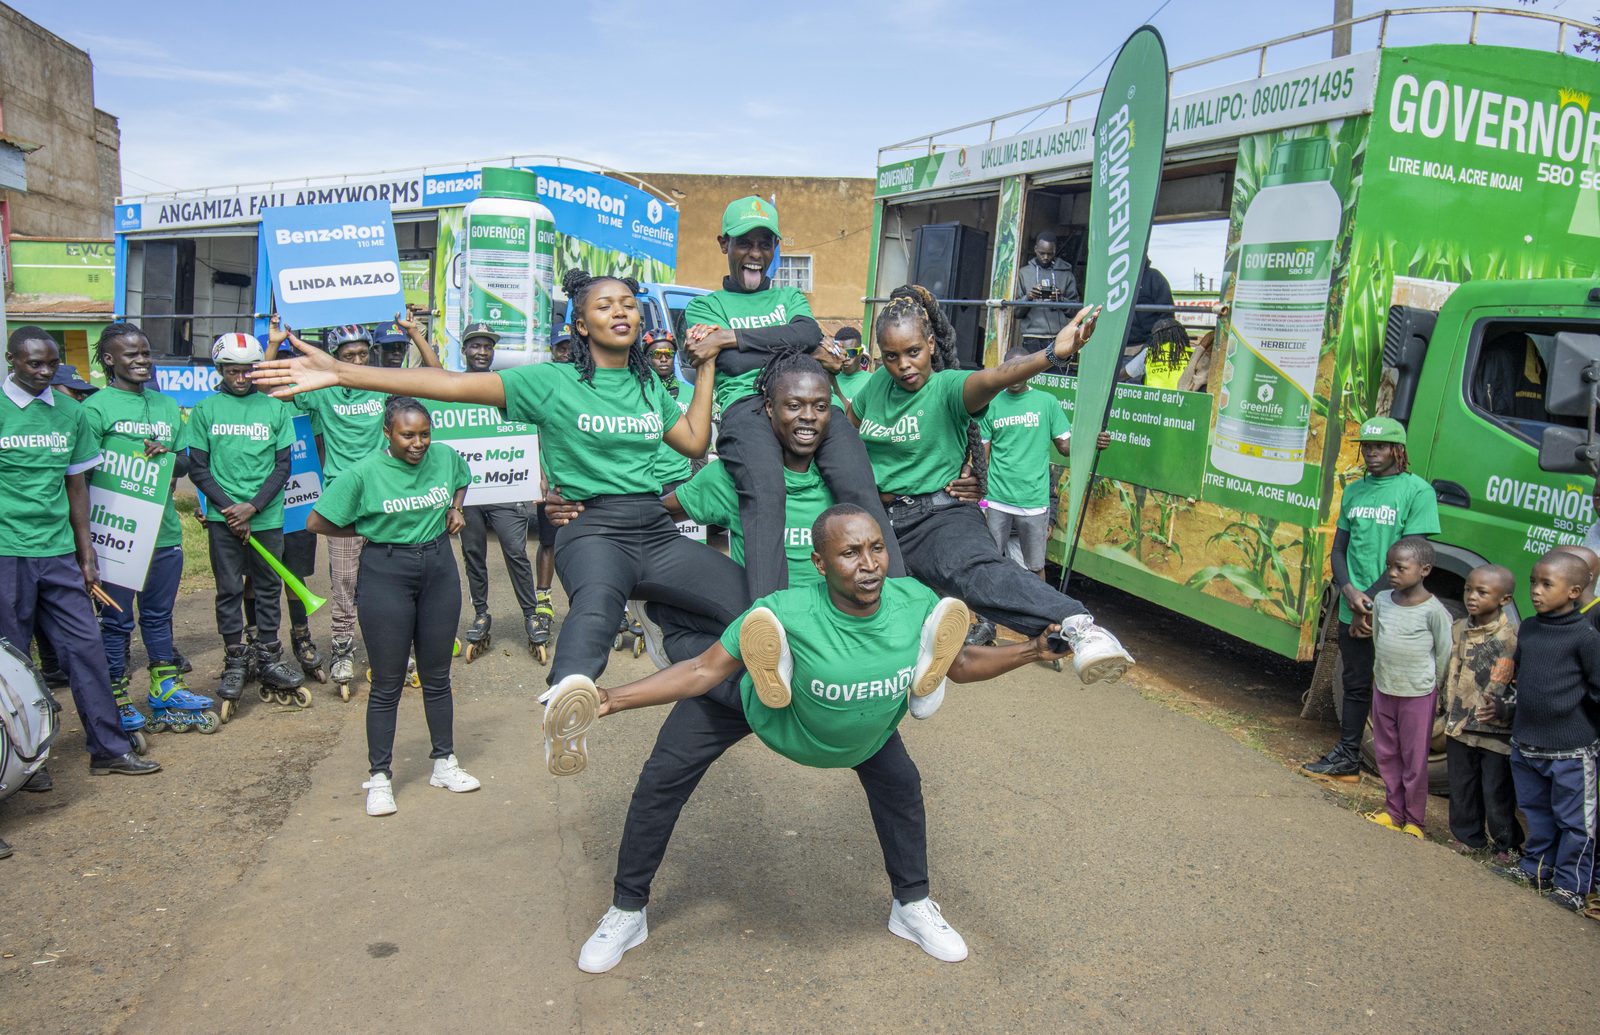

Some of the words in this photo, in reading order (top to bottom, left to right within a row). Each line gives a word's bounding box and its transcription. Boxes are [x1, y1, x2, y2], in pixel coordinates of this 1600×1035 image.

[1183, 92, 1248, 130] MALIPO:
[1252, 67, 1355, 117] 0800721495
[1389, 74, 1600, 165] GOVERNOR
[981, 142, 1018, 169] UKULIMA
[1020, 137, 1042, 161] BILA
[1044, 127, 1088, 157] JASHO!!
[880, 166, 915, 189] GOVERNOR
[1388, 155, 1421, 176] LITRE
[1422, 161, 1456, 184] MOJA,
[1458, 167, 1489, 187] ACRE
[1489, 172, 1523, 192] MOJA!
[1536, 162, 1574, 187] 580
[537, 176, 626, 217] enzoRon
[158, 198, 244, 224] ANGAMIZA
[610, 217, 623, 229] ME
[631, 219, 674, 243] Greenlife
[471, 226, 526, 240] GOVERNOR
[538, 230, 555, 244] GOVE
[371, 239, 385, 247] ME
[1245, 251, 1315, 269] GOVERNOR
[289, 277, 336, 291] LINDA
[340, 272, 395, 287] MAZAO
[1260, 340, 1308, 350] HERBICIDE
[1047, 376, 1059, 387] 580
[1060, 377, 1070, 389] SE
[1114, 386, 1142, 399] rgence
[1144, 389, 1160, 402] and
[1162, 392, 1184, 407] early
[1239, 400, 1284, 415] Greenlife
[431, 407, 521, 429] GOVERN
[994, 414, 1039, 429] GOVERNOR
[1109, 408, 1120, 419] ed
[1122, 409, 1131, 420] to
[1132, 412, 1162, 426] control
[1163, 417, 1195, 431] annual
[115, 421, 172, 437] GOVERNOR
[211, 423, 269, 437] GOVERNOR
[496, 425, 513, 433] 580
[515, 424, 527, 432] SE
[0, 434, 67, 449] GOVERNOR
[891, 435, 907, 443] 580
[908, 433, 921, 441] SE
[1129, 432, 1151, 448] fields
[294, 451, 307, 460] ME
[485, 446, 525, 462] Moja
[284, 480, 301, 490] ZA
[485, 468, 529, 485] Moja!
[120, 479, 140, 493] 580
[142, 487, 156, 497] SE
[1226, 477, 1255, 497] MOJA,
[1256, 484, 1285, 502] ACRE
[1286, 491, 1320, 510] MOJA!
[284, 491, 320, 506] ORMS
[382, 487, 450, 514] GOVERNOR
[1486, 475, 1594, 523] GOVERNOR
[90, 504, 137, 534] lima
[1553, 518, 1574, 531] 580
[679, 524, 699, 534] dari
[1527, 525, 1558, 543] LITRE
[90, 532, 134, 553] asho!
[1523, 538, 1553, 556] ACRE
